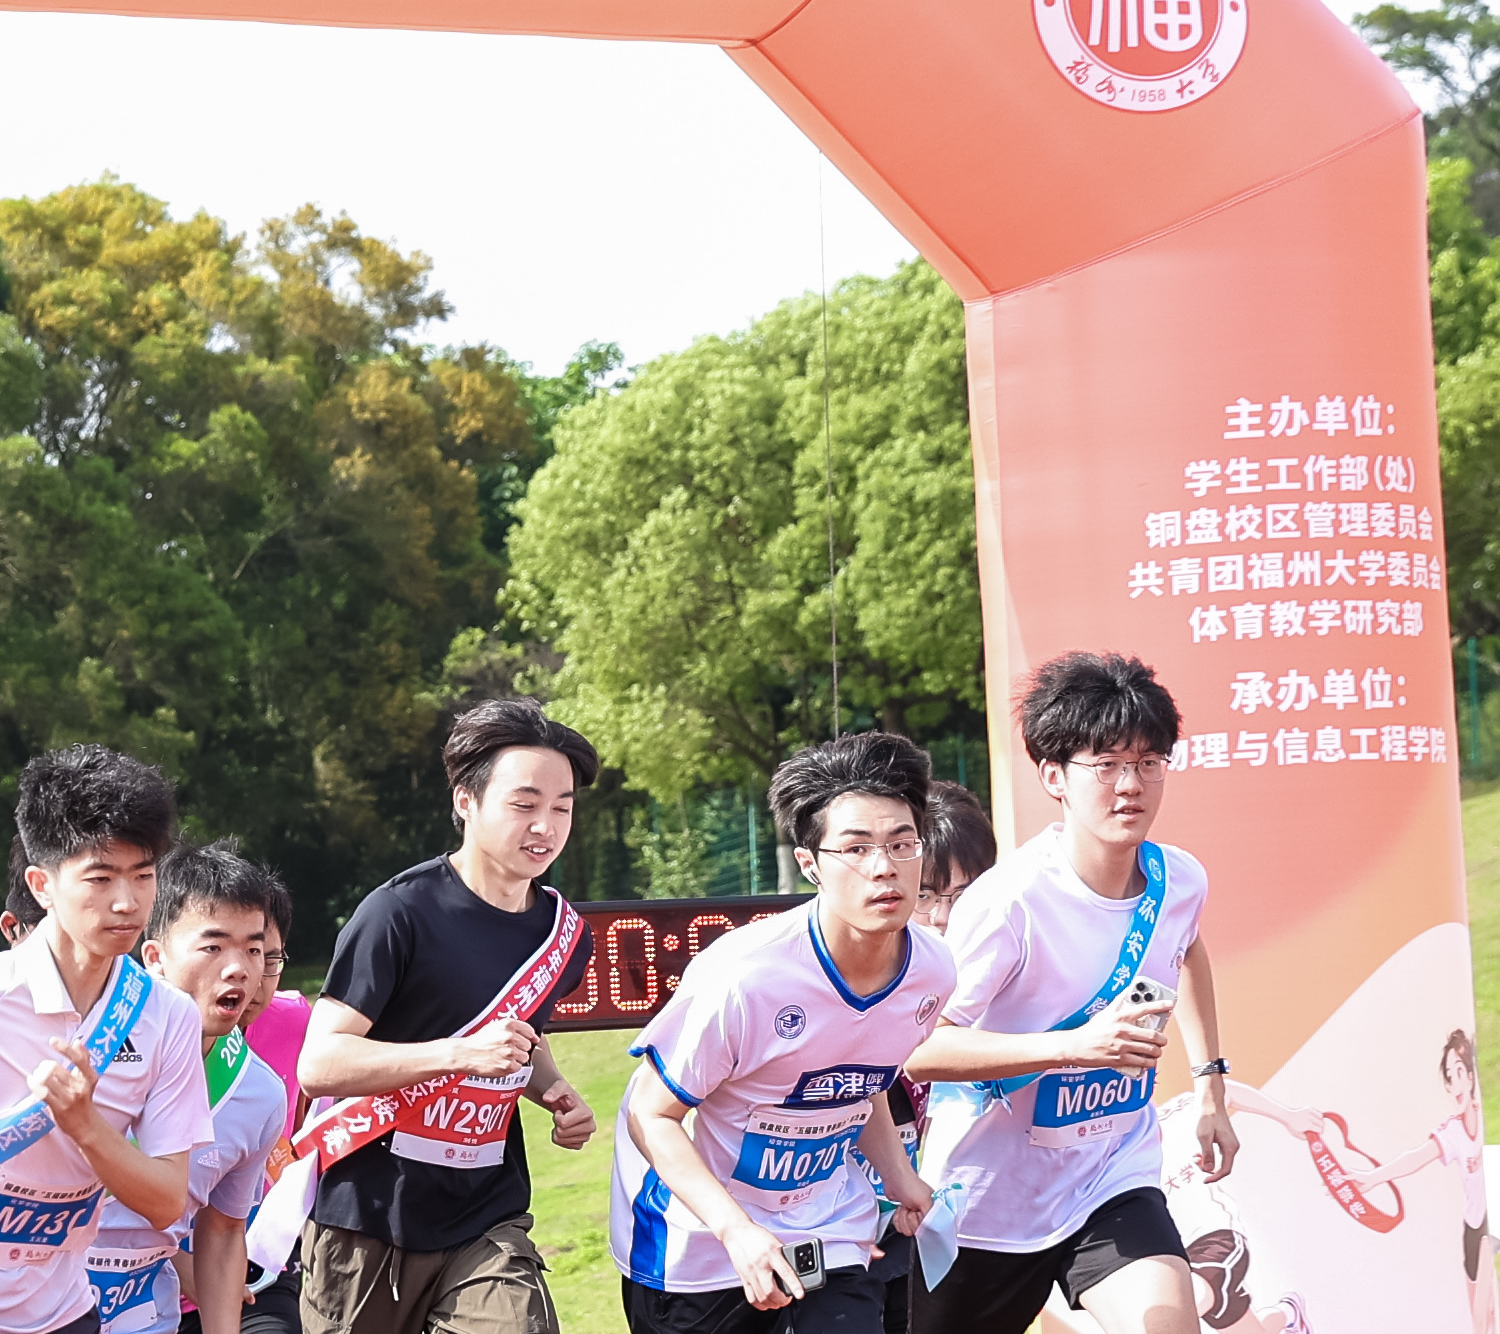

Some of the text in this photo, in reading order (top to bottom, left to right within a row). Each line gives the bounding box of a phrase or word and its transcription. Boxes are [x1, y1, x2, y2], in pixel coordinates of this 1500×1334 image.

[1131, 88, 1166, 103] 1958
[1223, 395, 1396, 440] 主办单位：
[1184, 454, 1415, 498] 学生工作部（处）
[1145, 501, 1434, 549] 铜盘校区管理委员会
[1127, 549, 1442, 598] 共青团福州大学委员会
[1189, 598, 1424, 643] 体育教学研究部
[1230, 667, 1407, 714] 承办单位：
[422, 1094, 512, 1135] W2901
[1056, 1069, 1149, 1117] M0601
[758, 1137, 852, 1181] M0701
